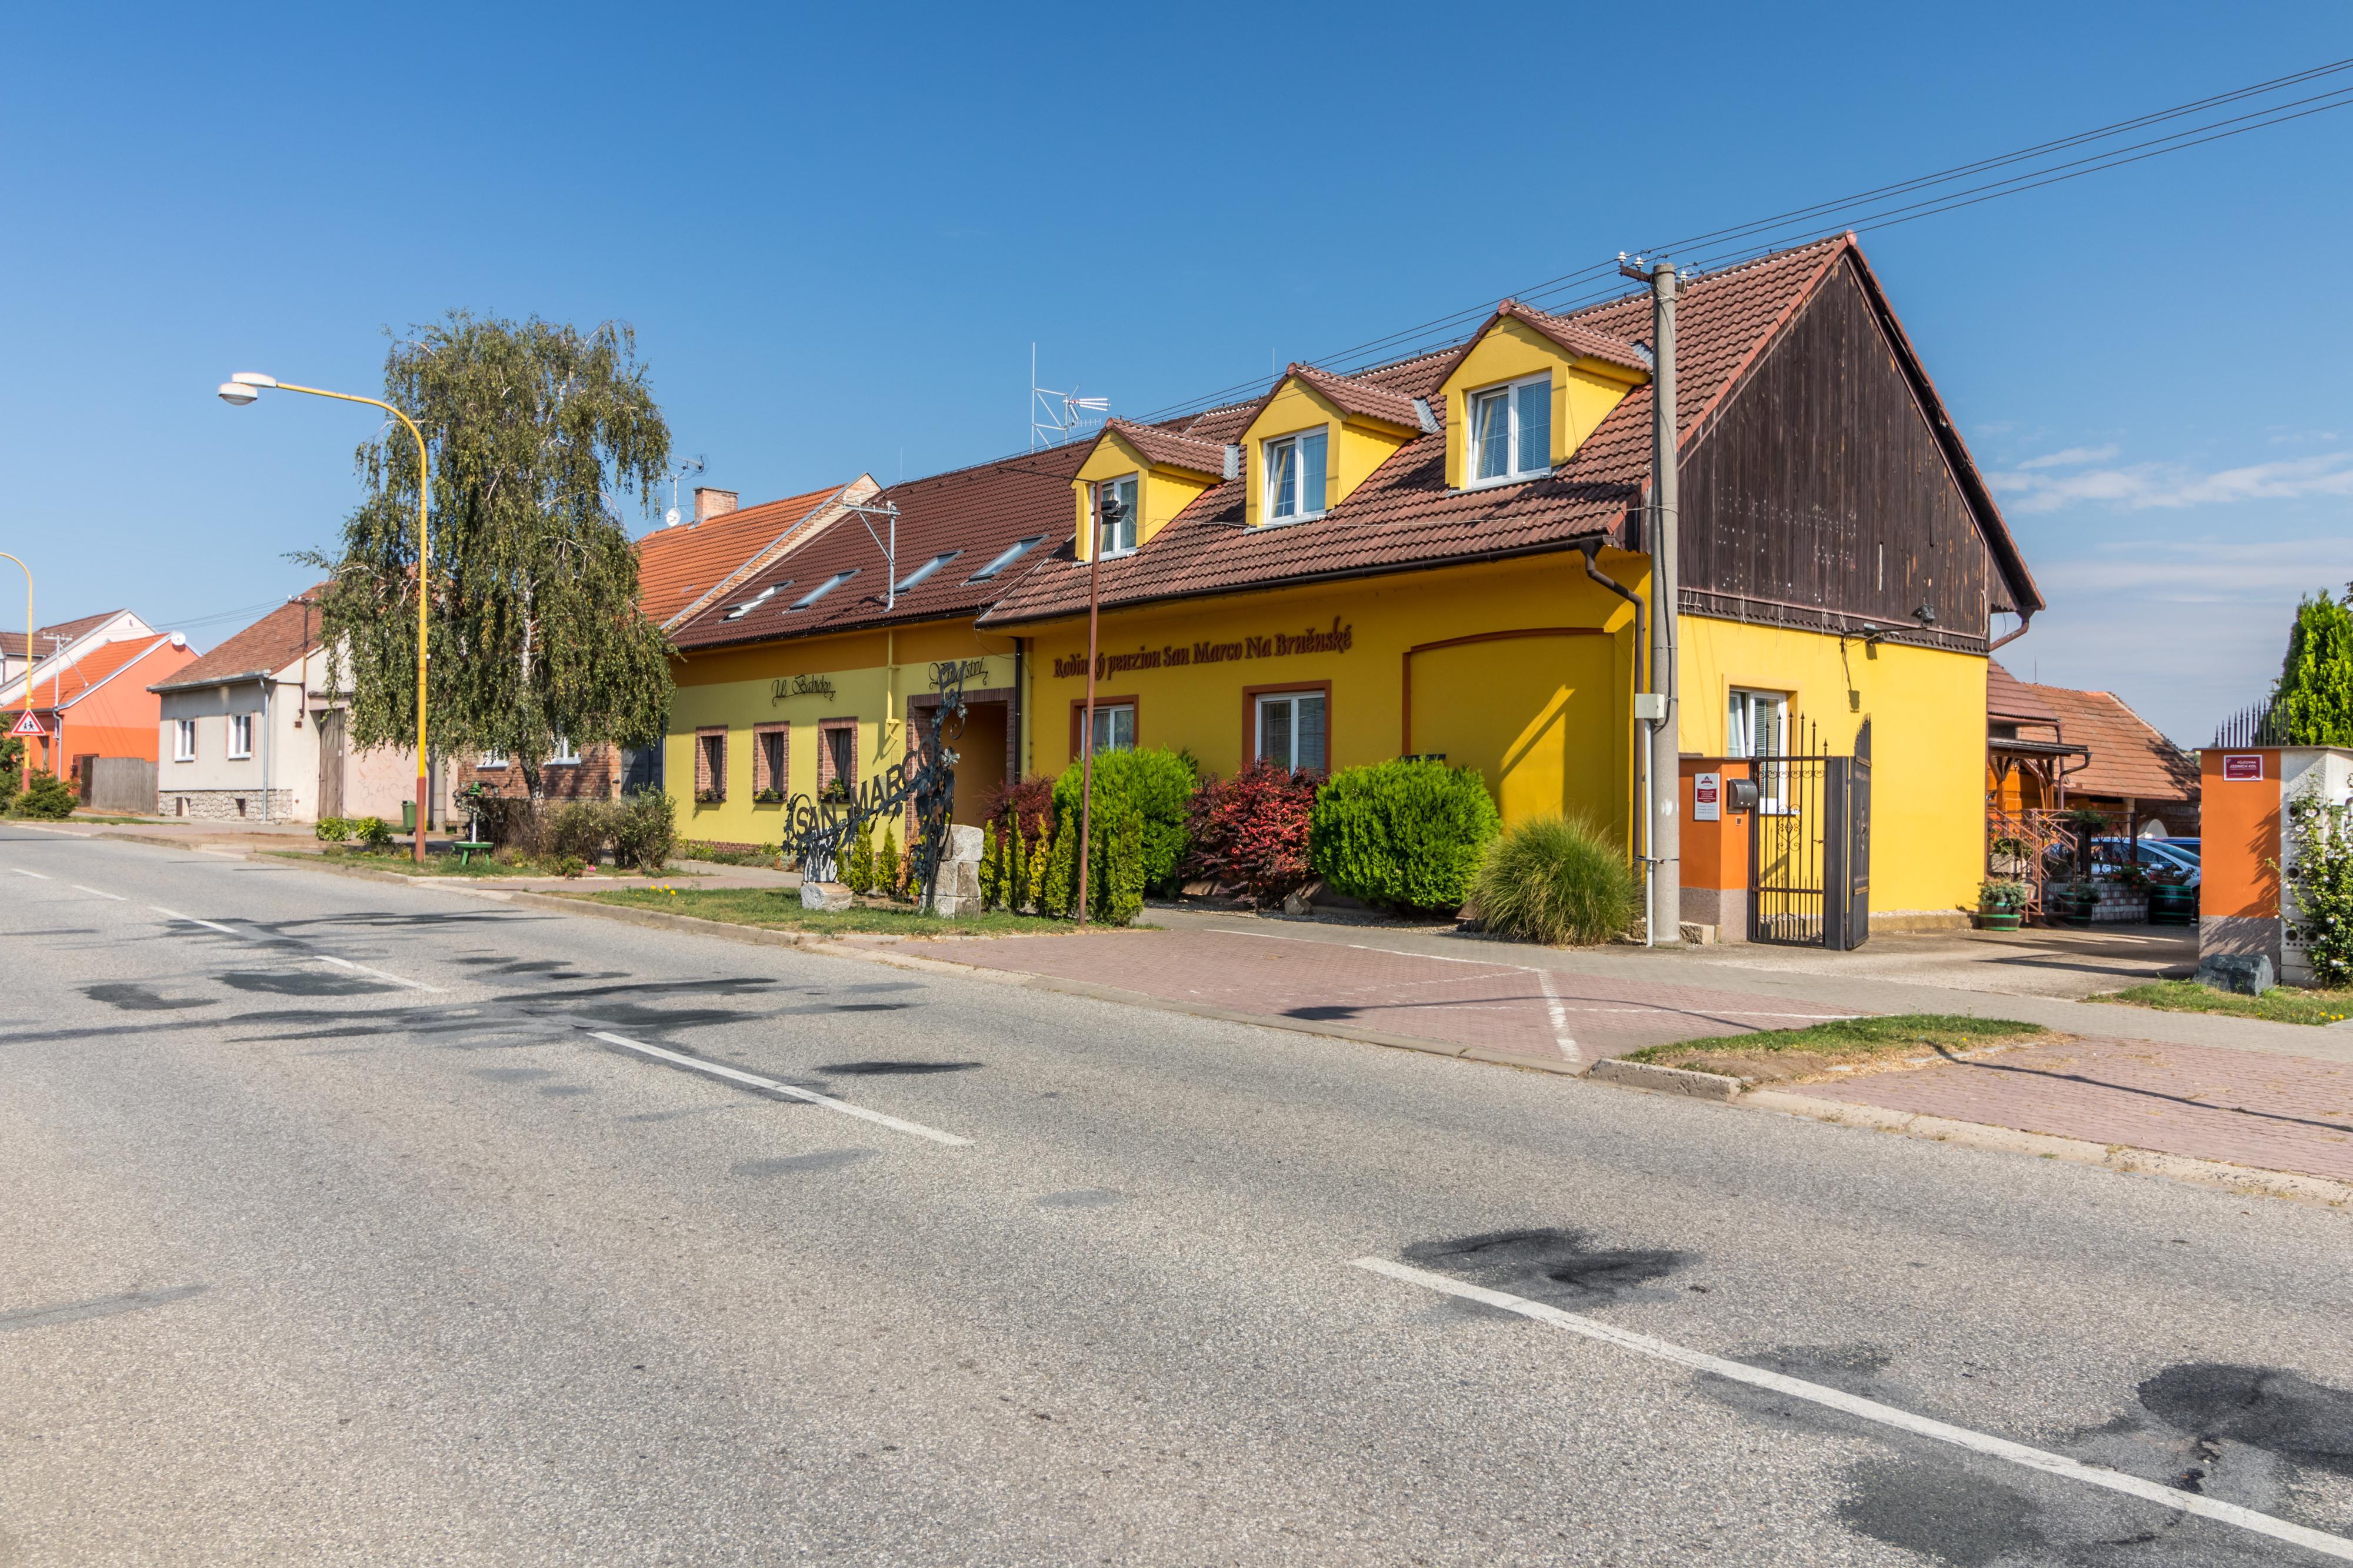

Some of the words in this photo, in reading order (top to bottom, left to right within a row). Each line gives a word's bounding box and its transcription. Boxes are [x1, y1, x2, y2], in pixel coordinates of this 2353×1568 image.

[1052, 652, 1106, 681] Rodiný
[1107, 645, 1161, 680] penzion
[1163, 645, 1190, 667] San
[1192, 641, 1243, 665] Marco
[1244, 636, 1272, 659] Na
[1274, 616, 1352, 655] Brněnské
[796, 797, 838, 836] SAN
[849, 735, 936, 813] MARCO
